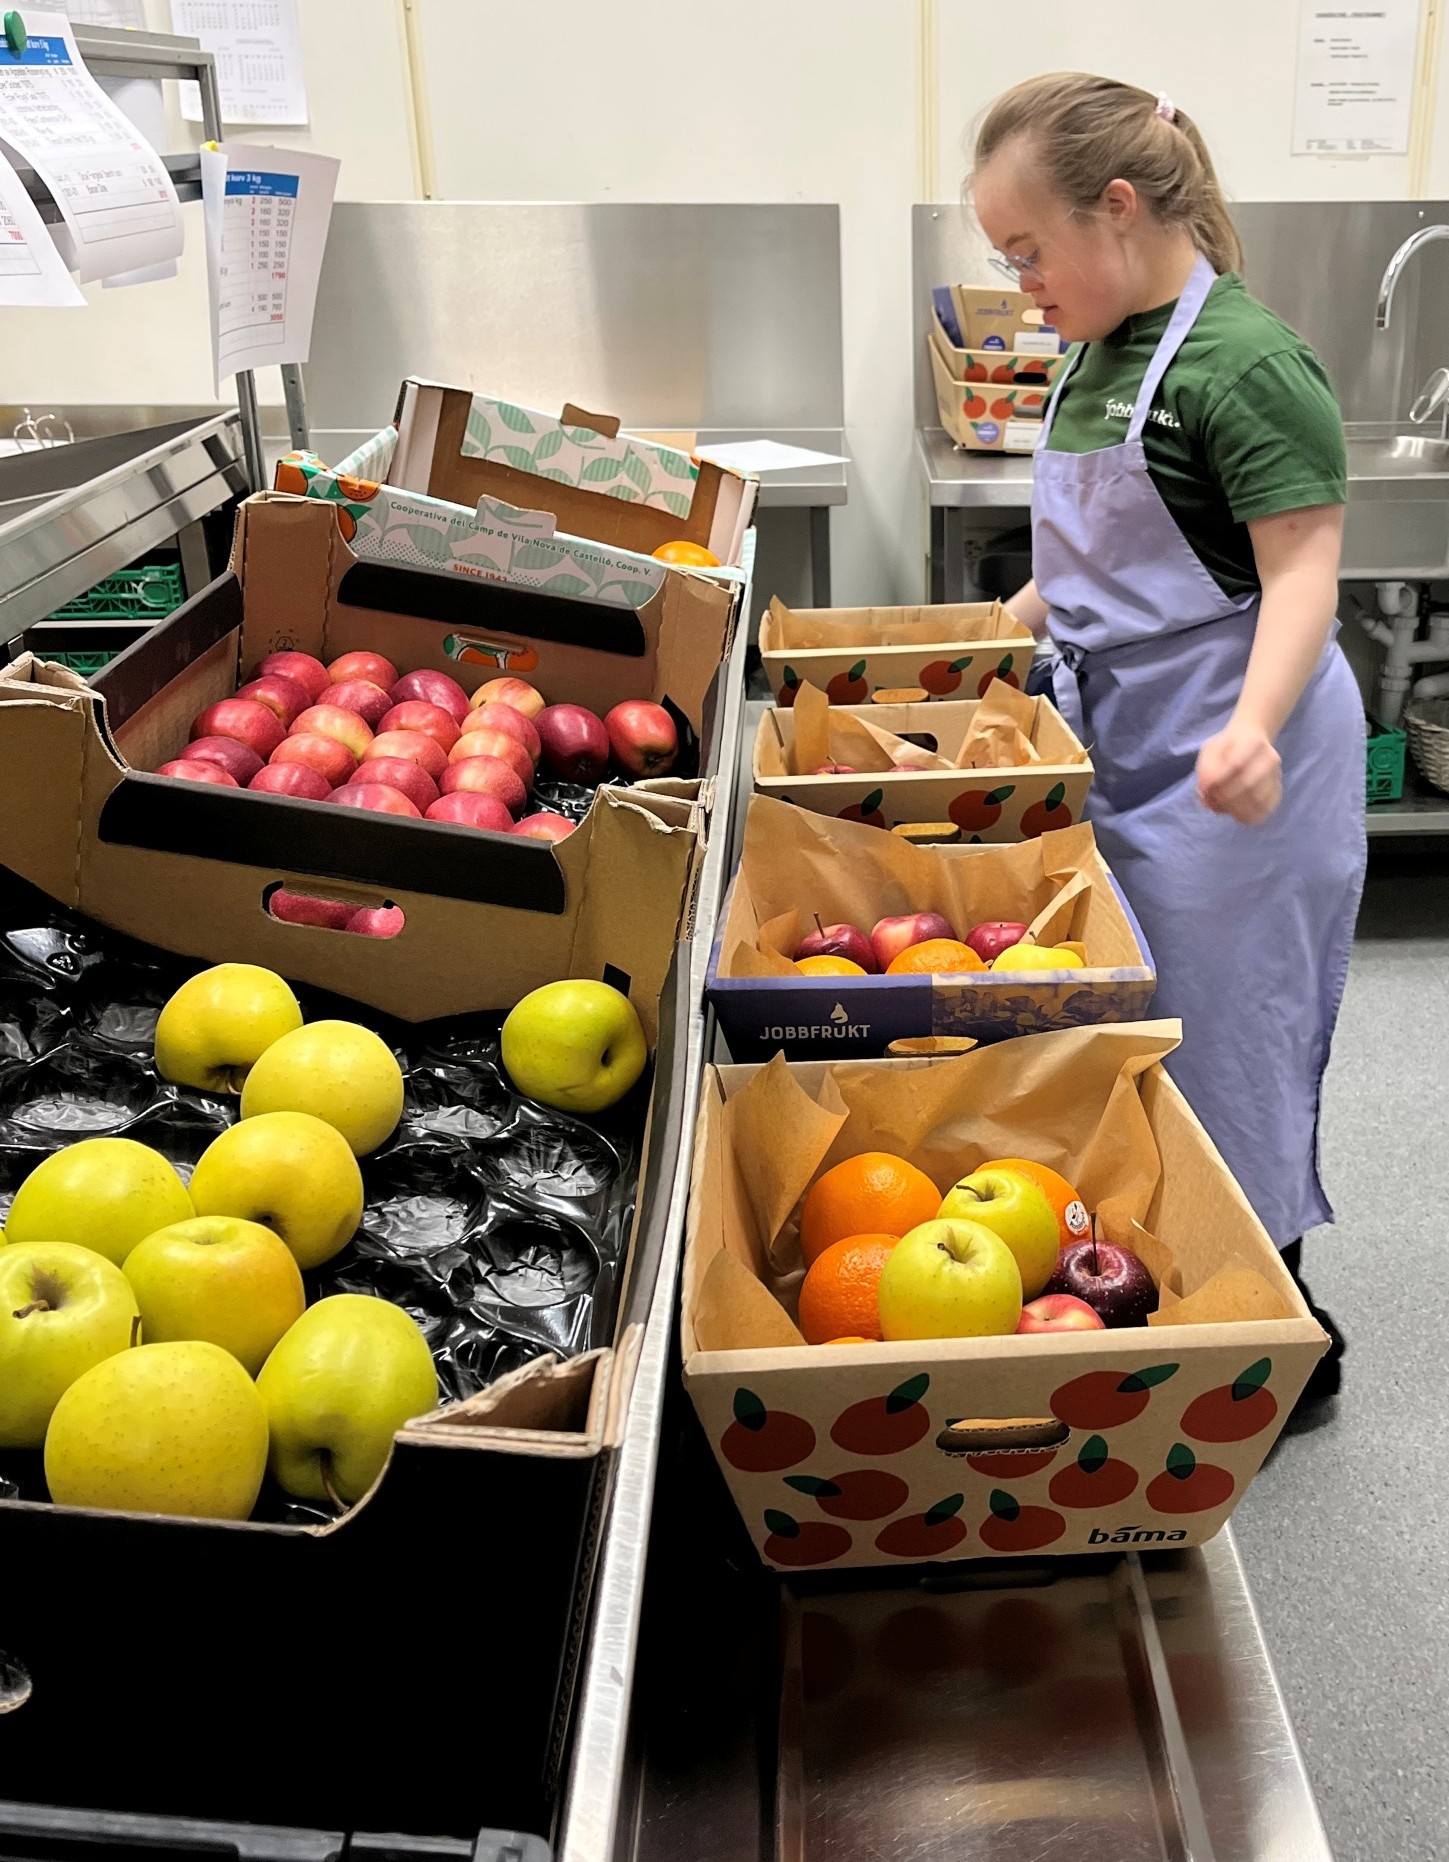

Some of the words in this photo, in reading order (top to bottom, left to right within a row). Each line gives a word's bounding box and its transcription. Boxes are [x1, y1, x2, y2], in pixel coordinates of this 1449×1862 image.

[231, 173, 245, 182] kurv
[252, 174, 261, 184] kg
[391, 501, 447, 522] Cooperativa
[450, 518, 465, 527] del
[468, 522, 494, 536] Camp
[497, 530, 509, 539] de
[512, 533, 529, 545] Vila
[532, 539, 556, 551] Nova
[559, 547, 571, 555] de
[616, 561, 641, 574] Coop.
[453, 564, 482, 577] SINCE
[760, 1025, 871, 1040] JOBBFRUKT
